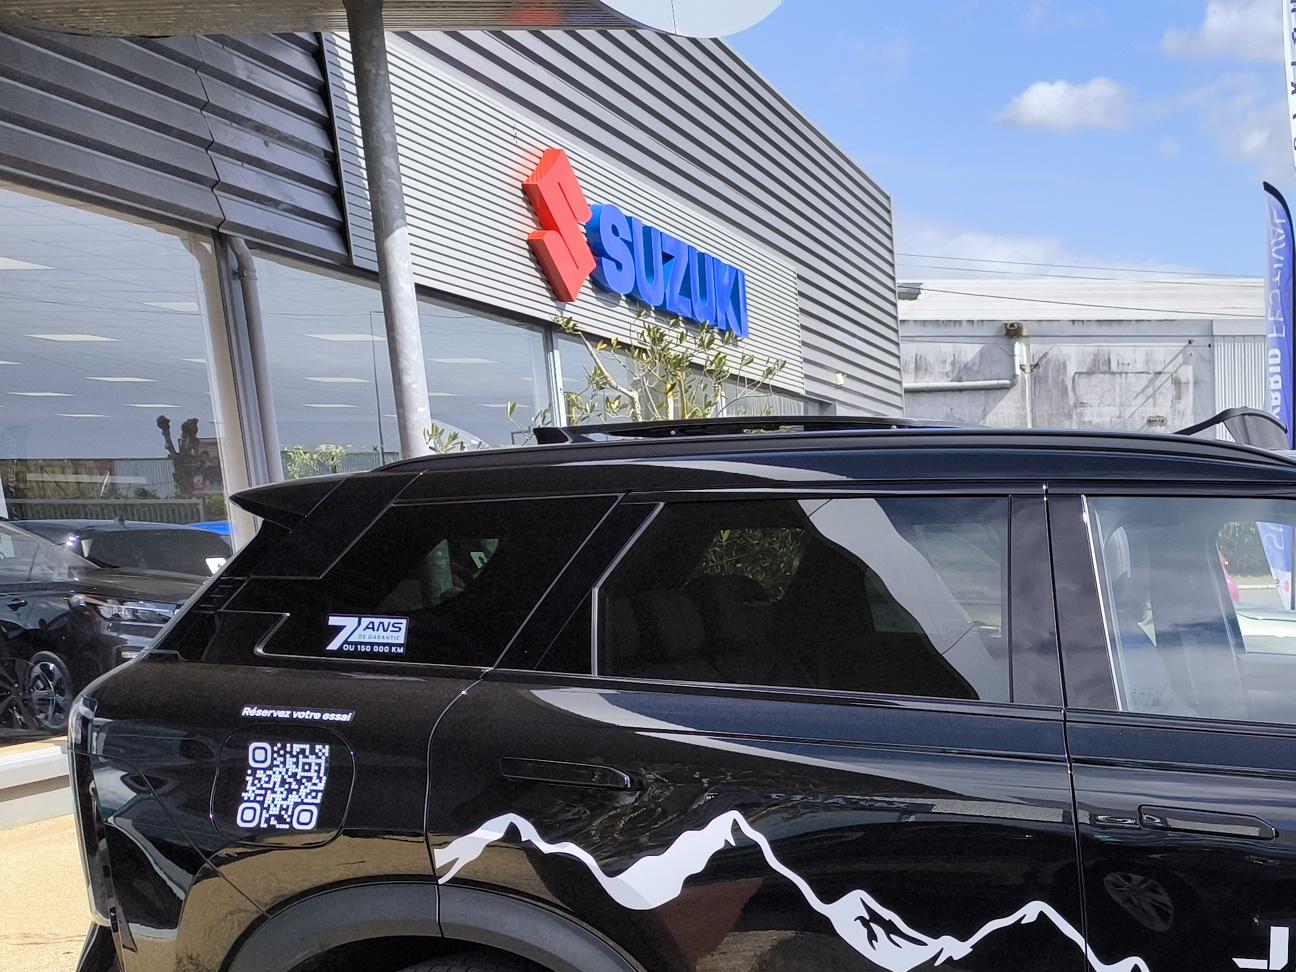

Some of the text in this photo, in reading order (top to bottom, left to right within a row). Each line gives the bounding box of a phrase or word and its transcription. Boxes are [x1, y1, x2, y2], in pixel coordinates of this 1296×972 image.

[586, 204, 749, 338] SUZUKI
[326, 616, 404, 651] 7 ANS
[342, 644, 355, 652] OU
[373, 645, 390, 653] 000
[391, 646, 404, 654] KM
[242, 706, 353, 722] Réservez votre essai
